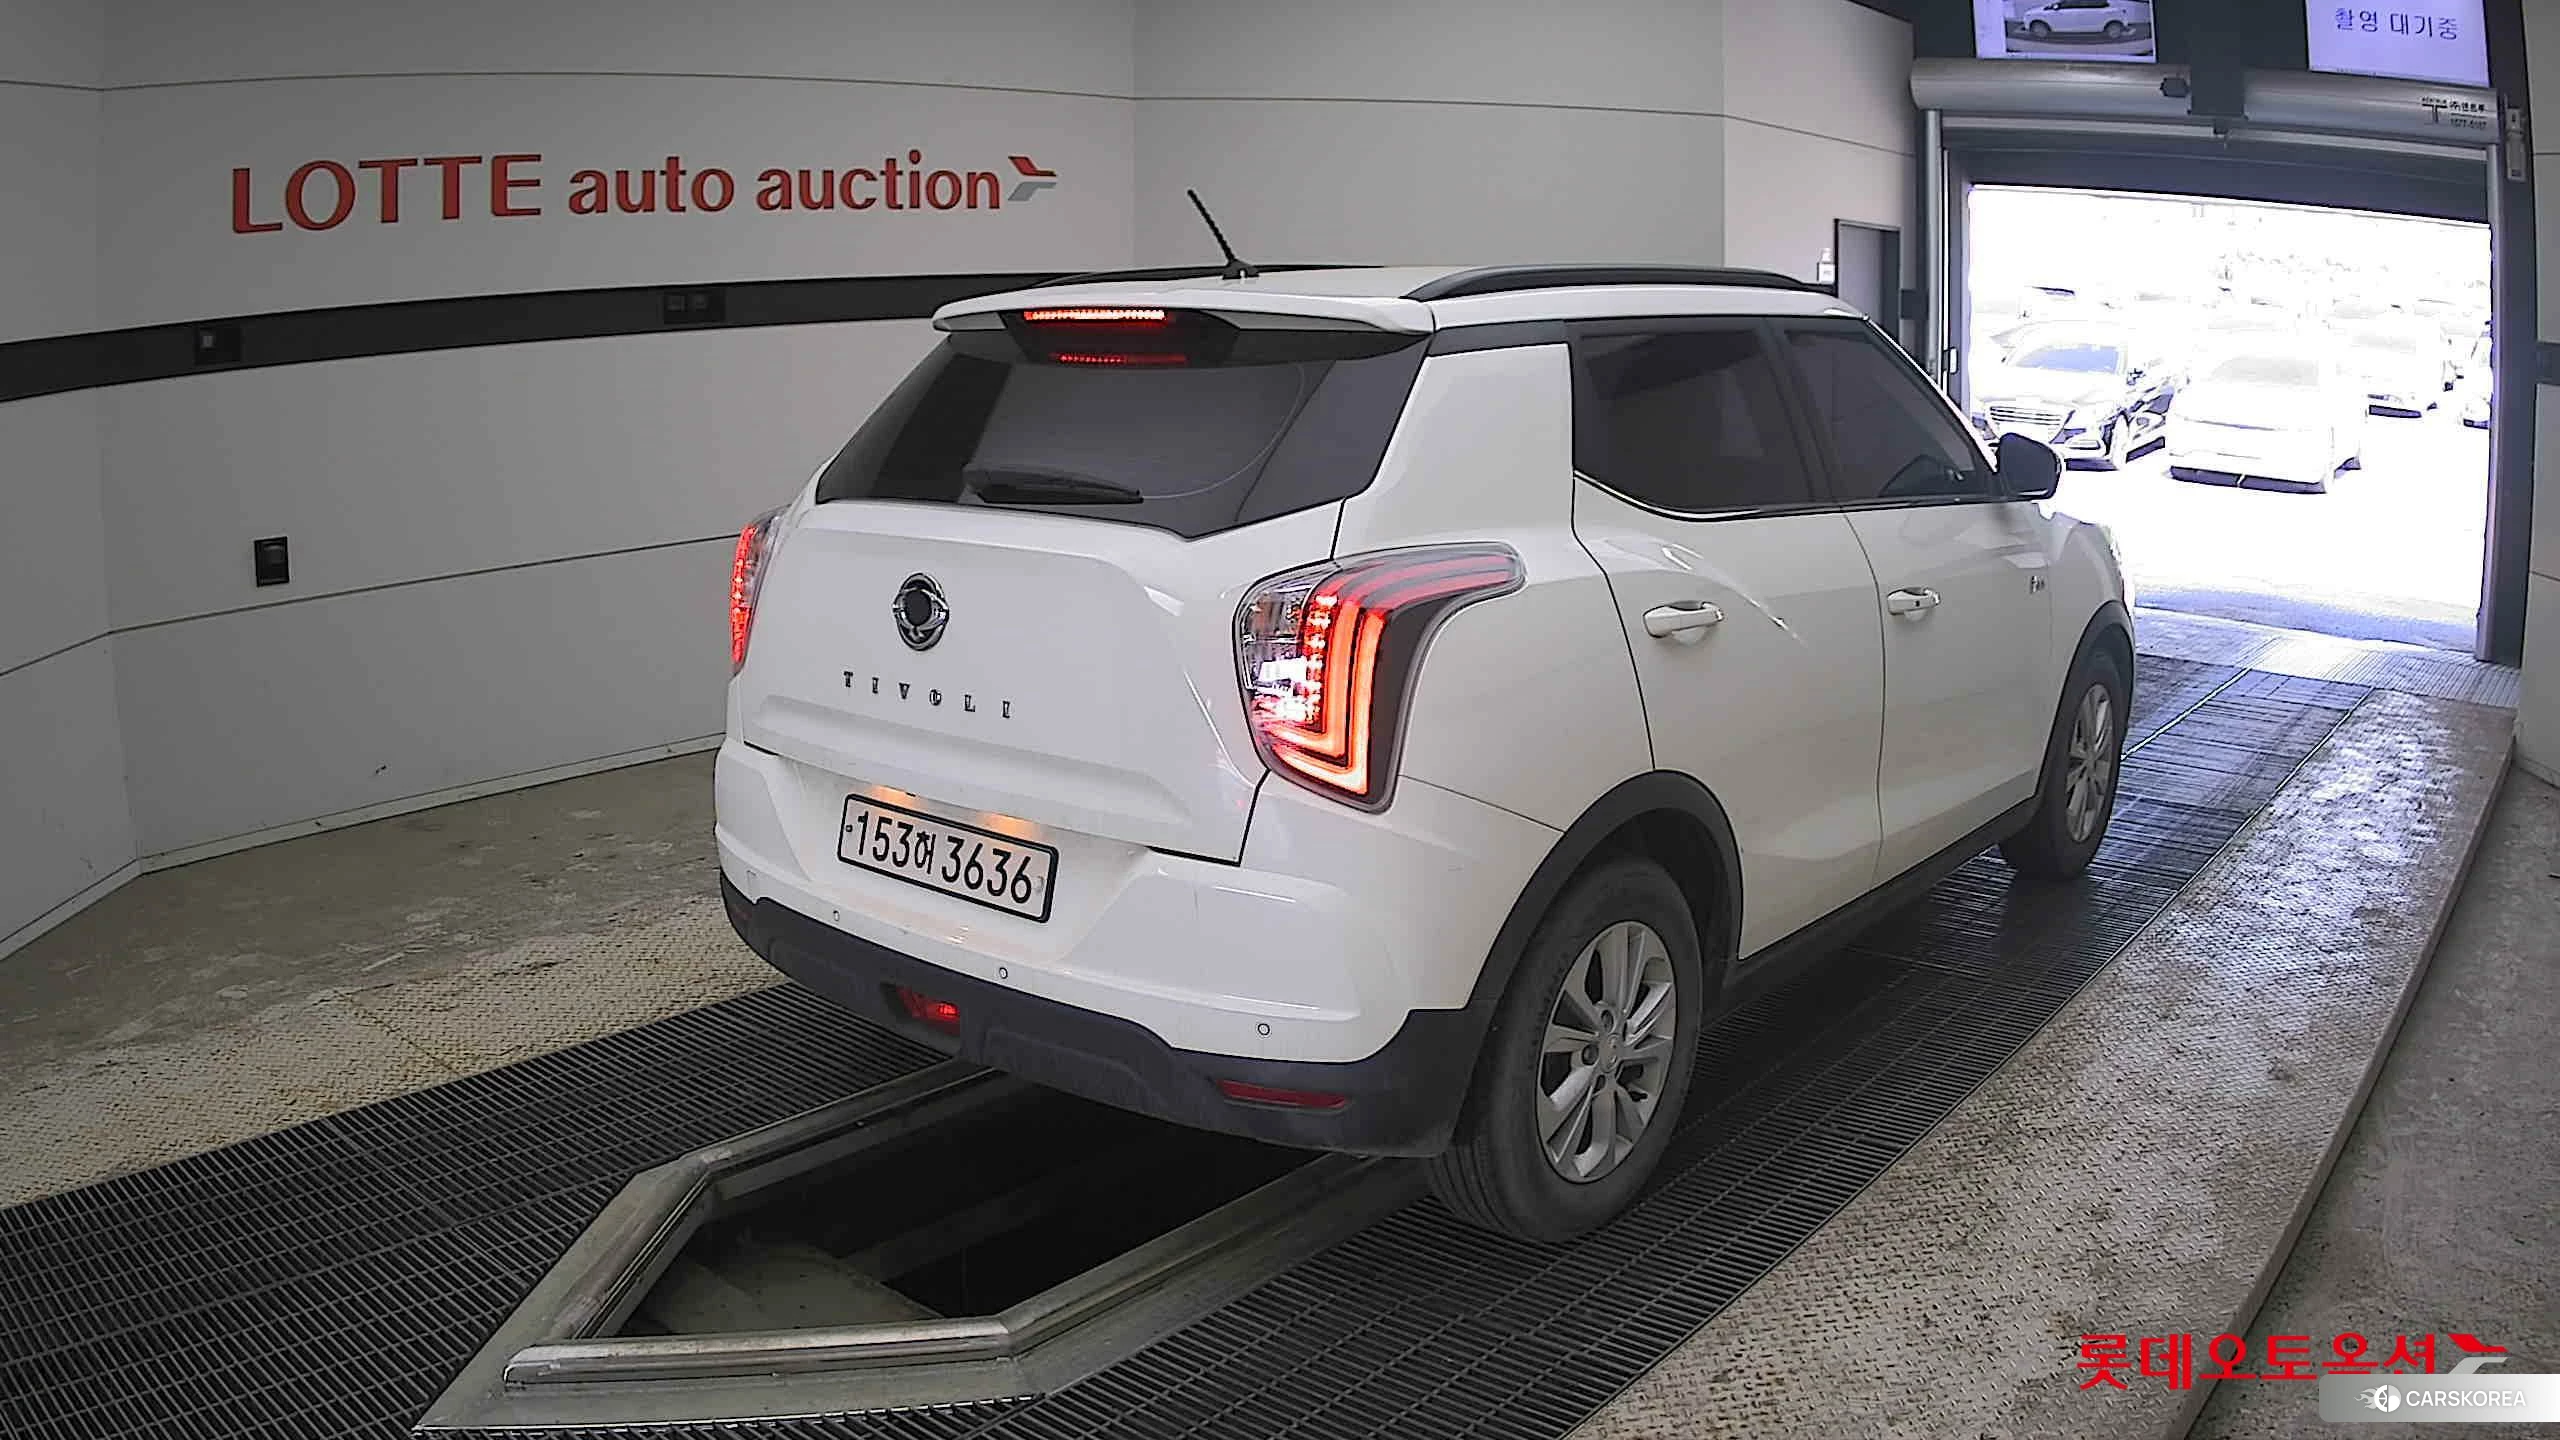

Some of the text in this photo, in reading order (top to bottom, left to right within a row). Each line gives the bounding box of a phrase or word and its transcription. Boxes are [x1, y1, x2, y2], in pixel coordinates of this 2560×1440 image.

[2335, 8, 2457, 40] 촬영 대기중
[232, 149, 1001, 234] LOTTE auto auction
[843, 671, 1011, 719] TIVOLI
